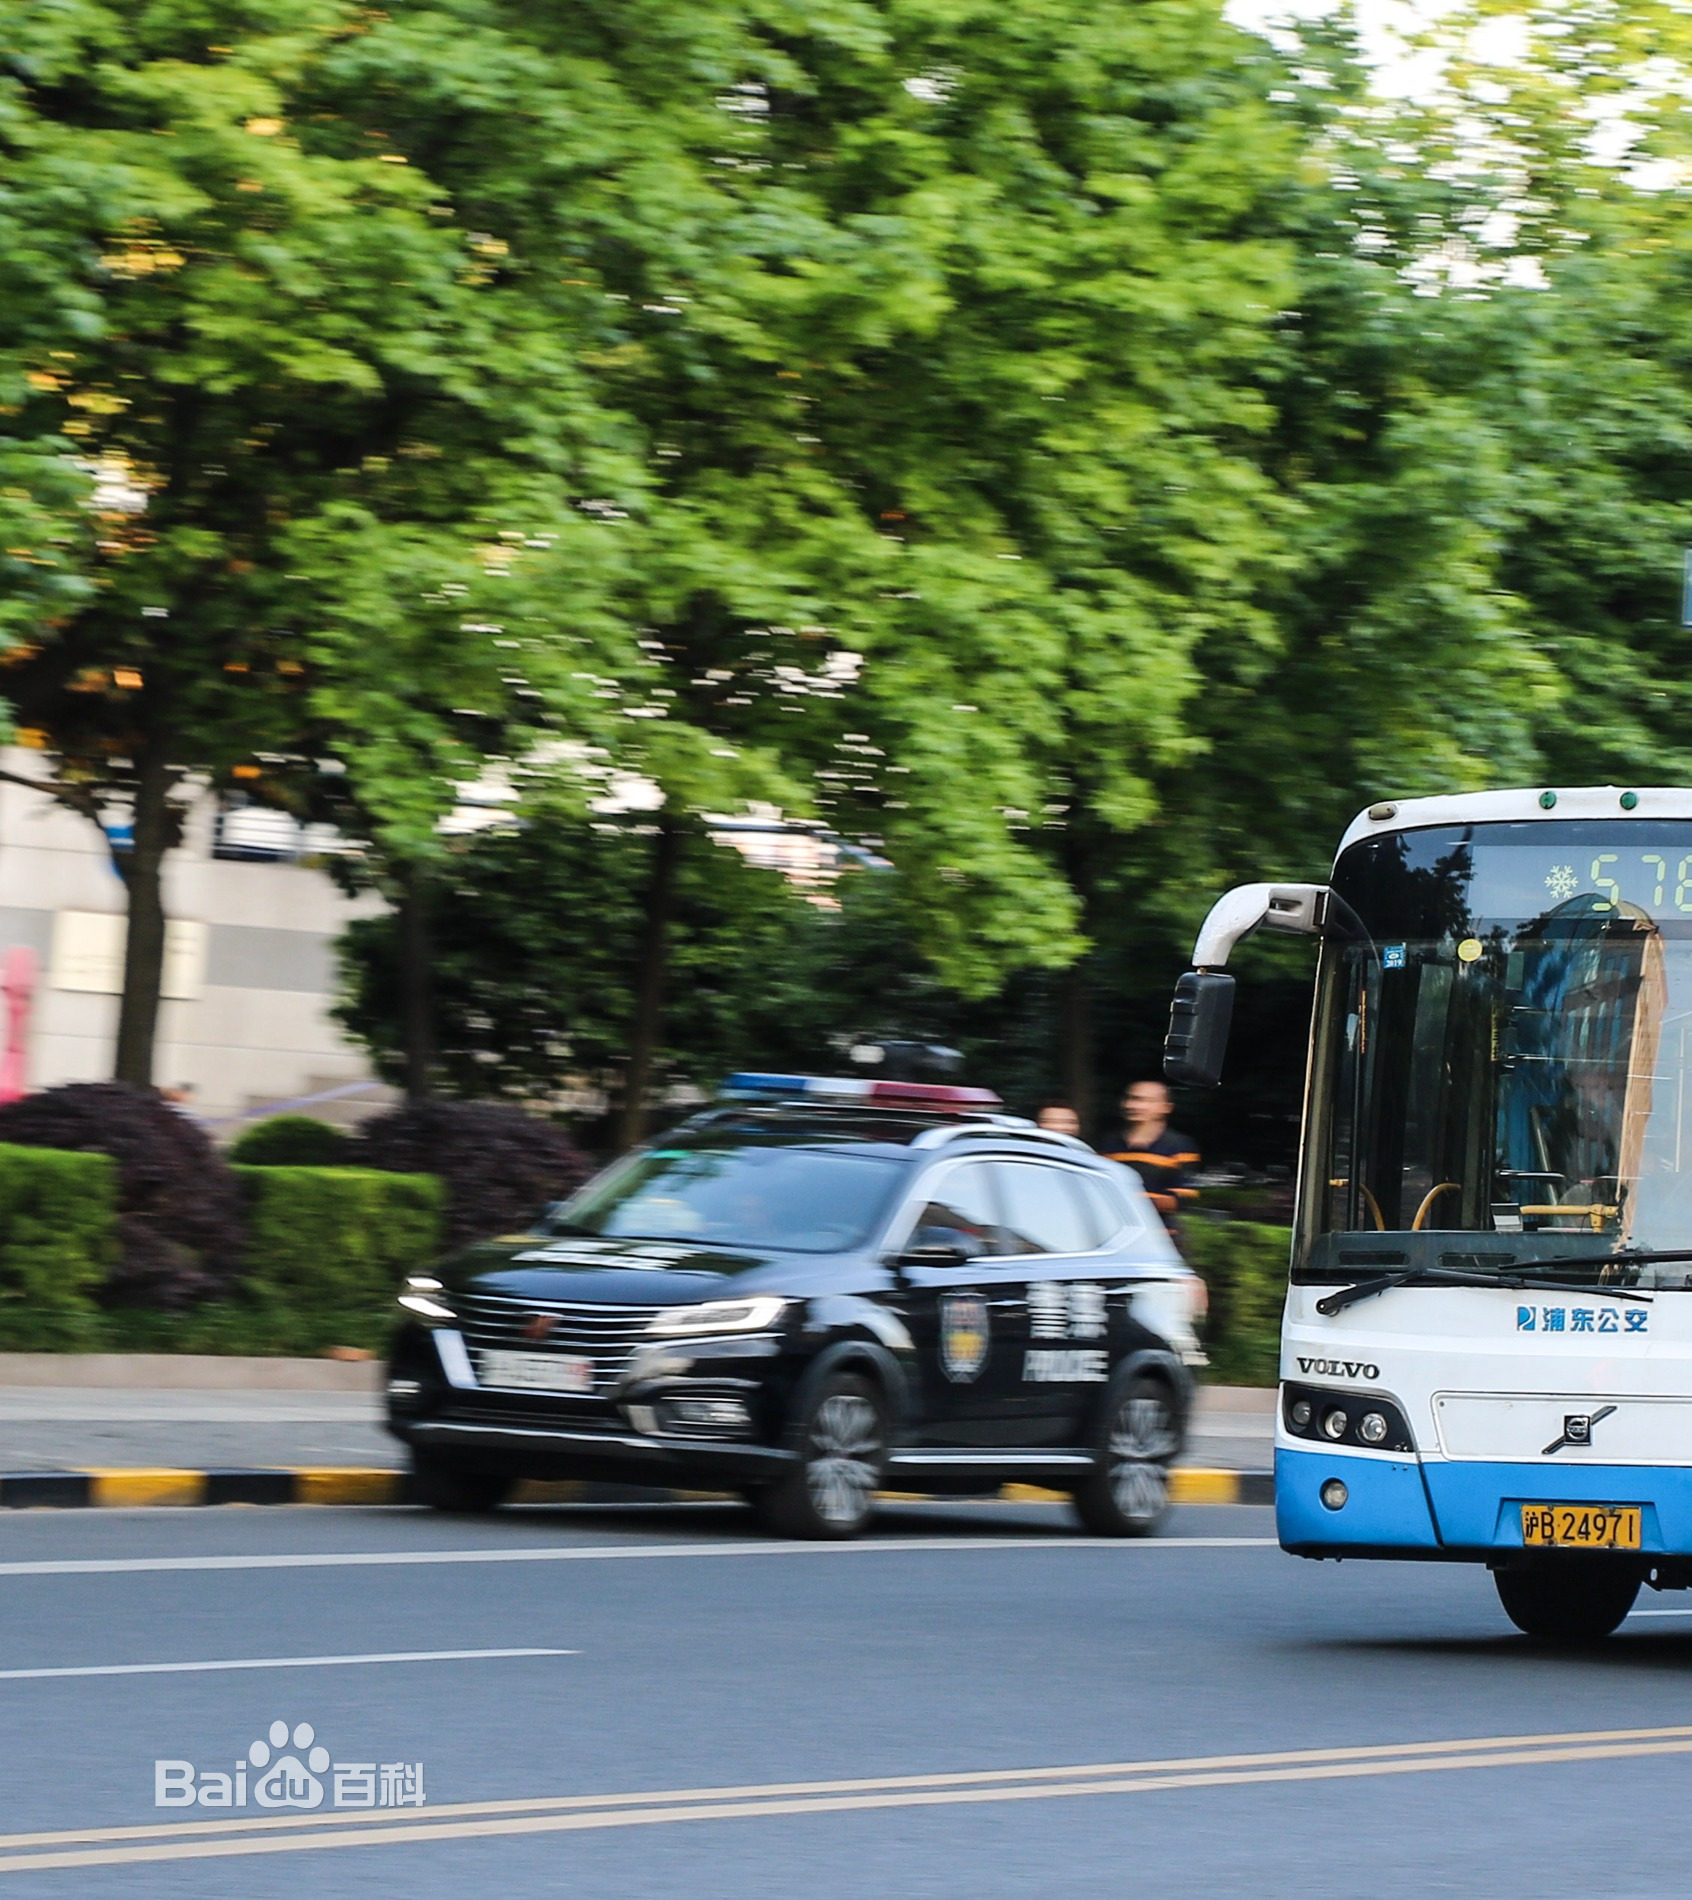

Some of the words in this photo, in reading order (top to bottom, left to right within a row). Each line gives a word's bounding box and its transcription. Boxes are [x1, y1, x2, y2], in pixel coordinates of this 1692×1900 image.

[1542, 1308, 1649, 1333] 浦东公交
[1296, 1357, 1380, 1380] VOLVO
